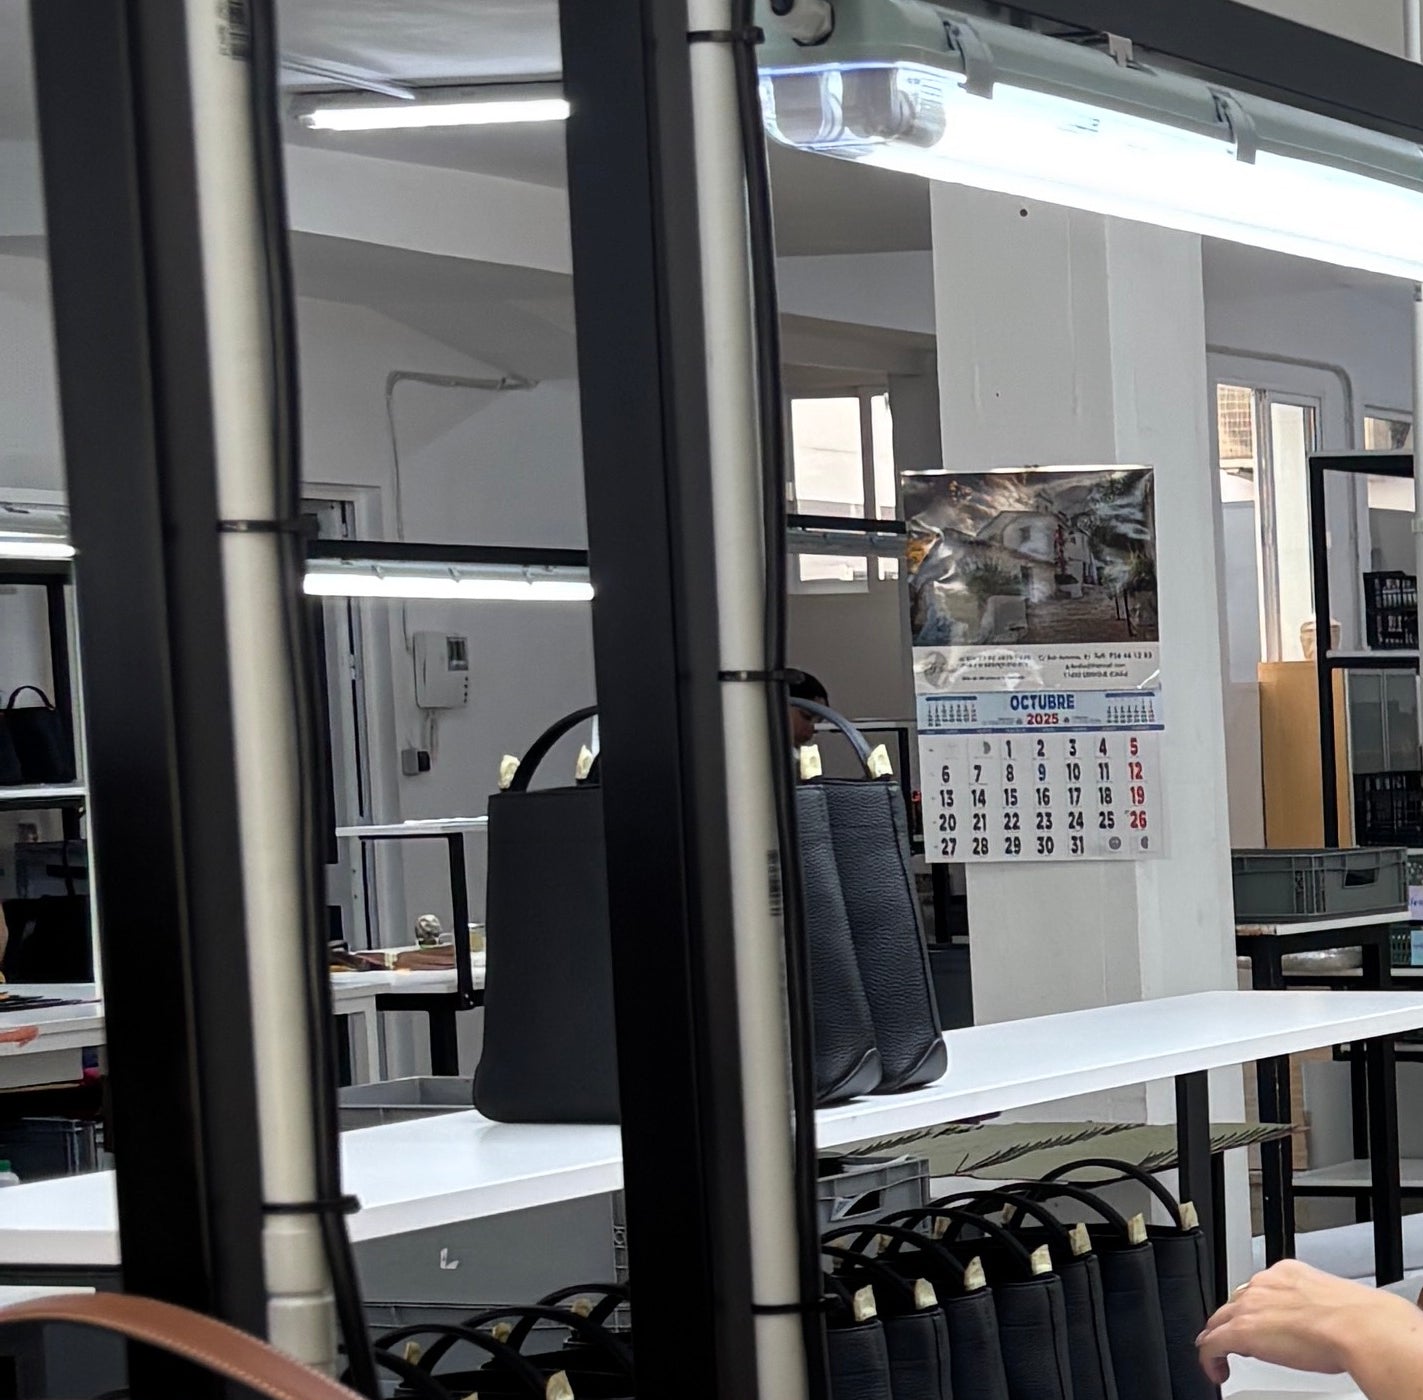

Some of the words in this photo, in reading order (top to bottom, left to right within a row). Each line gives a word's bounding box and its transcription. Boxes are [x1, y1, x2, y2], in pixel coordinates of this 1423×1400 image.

[1010, 694, 1075, 711] OCTUBRE
[1026, 713, 1060, 725] 2025
[1005, 739, 1012, 759] 1
[1036, 738, 1046, 758] 2
[1068, 738, 1077, 757] 3
[1098, 737, 1108, 757] 4
[1129, 736, 1139, 757] 5
[941, 764, 951, 784] 6
[973, 764, 982, 783] 7
[1005, 763, 1015, 783] 8
[1037, 762, 1047, 782] 9
[1065, 762, 1081, 782] 10
[1098, 762, 1110, 781] 11
[1127, 761, 1144, 781] 12
[939, 789, 954, 808] 13
[970, 788, 987, 808] 14
[1003, 787, 1018, 807] 15
[1035, 786, 1051, 807] 16
[1067, 786, 1082, 806] 17
[1098, 786, 1113, 806] 18
[1129, 785, 1145, 805] 19
[938, 813, 957, 832] 20
[972, 812, 987, 832] 21
[1003, 811, 1021, 831] 22
[1035, 811, 1053, 831] 23
[1067, 810, 1085, 830] 24
[1098, 810, 1115, 830] 25
[1129, 810, 1147, 829] 26
[940, 837, 957, 857] 27
[972, 836, 989, 856] 28
[1004, 835, 1022, 855] 29
[1036, 835, 1055, 855] 30
[1070, 835, 1085, 855] 31
